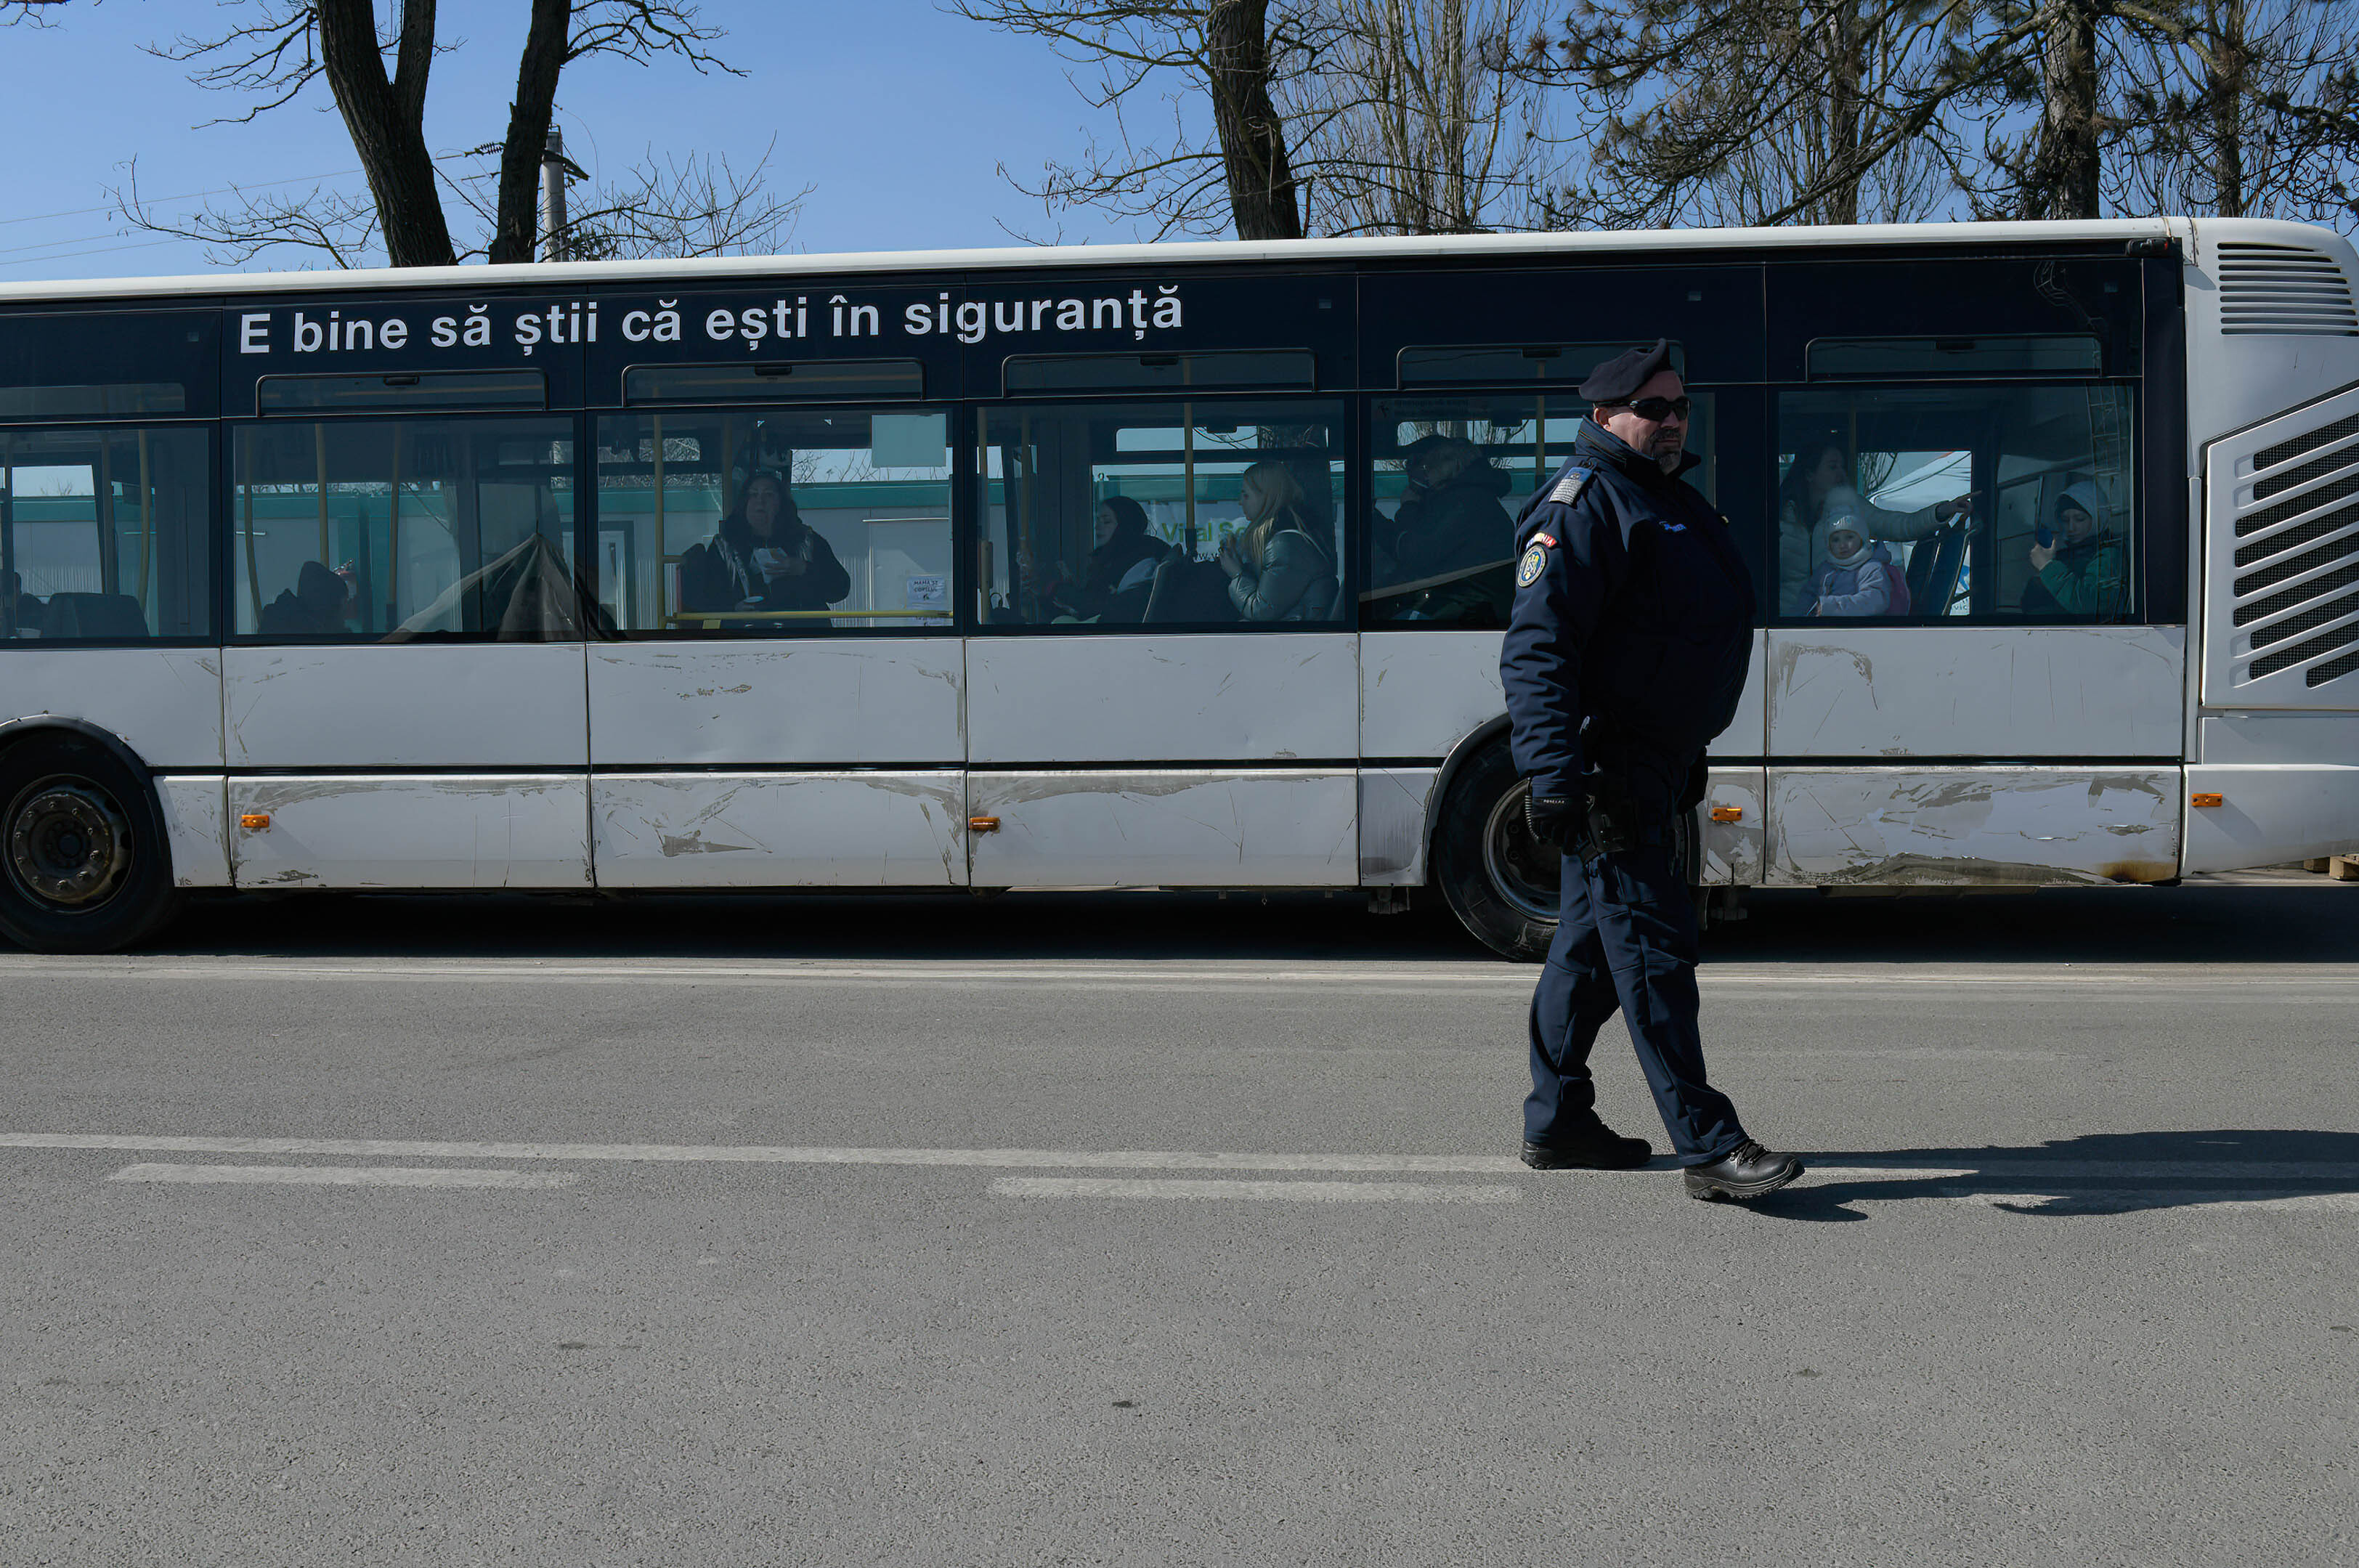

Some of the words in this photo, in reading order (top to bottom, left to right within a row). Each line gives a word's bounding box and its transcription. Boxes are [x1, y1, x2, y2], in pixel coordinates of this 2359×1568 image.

[241, 313, 271, 354] E
[293, 312, 408, 354] bine
[431, 304, 491, 347] să
[515, 302, 597, 356] știi
[622, 298, 681, 342] că
[706, 296, 807, 351] ești
[829, 295, 879, 337] în
[904, 285, 1182, 344] siguranță
[1161, 522, 1213, 543] Vial
